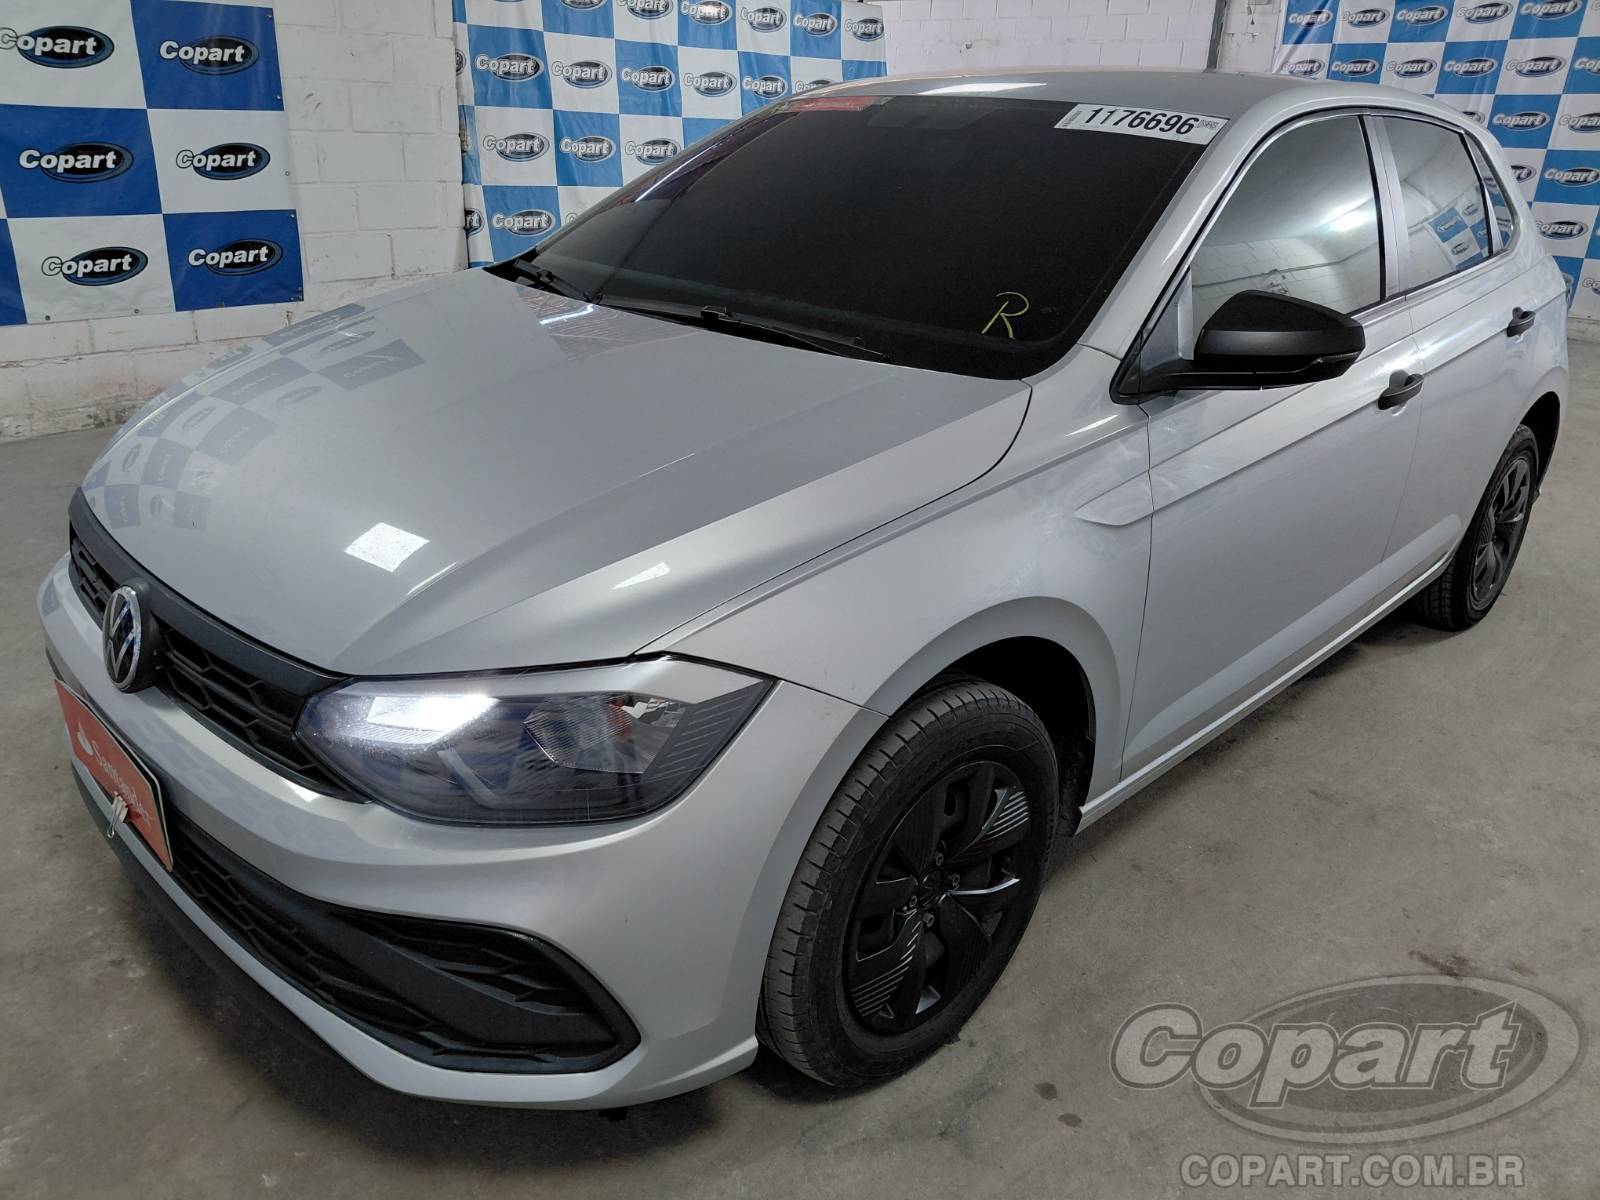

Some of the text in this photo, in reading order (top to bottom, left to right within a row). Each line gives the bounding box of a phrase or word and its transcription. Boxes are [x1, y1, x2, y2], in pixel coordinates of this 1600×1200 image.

[680, 1, 727, 19] Copart
[741, 7, 782, 25] Copart
[1341, 10, 1385, 23] Copart
[1396, 7, 1445, 23] Copart
[1456, 3, 1509, 19] Copart
[1520, 0, 1578, 16] Copart
[793, 14, 833, 31] Copart
[844, 19, 883, 34] Copart
[1289, 13, 1328, 24] Copart
[0, 27, 97, 56] Copart
[160, 40, 245, 64] Copart
[476, 54, 536, 75] Copart
[552, 61, 605, 80] Copart
[1331, 60, 1374, 74] Copart
[1386, 60, 1433, 74] Copart
[1443, 59, 1493, 75] Copart
[1506, 58, 1562, 73] Copart
[621, 68, 672, 86] Copart
[684, 72, 731, 91] Copart
[742, 76, 784, 94] Copart
[1085, 107, 1200, 135] 1176696
[1492, 112, 1546, 128] Copart
[1558, 113, 1600, 128] Copa
[483, 135, 542, 153] Copart
[560, 138, 610, 156] Copart
[625, 142, 674, 158] Copart
[19, 149, 117, 173] Copart
[176, 150, 256, 170] Copart
[1544, 168, 1597, 183] Copart
[492, 212, 549, 232] Copart
[42, 253, 133, 278] Copart
[188, 246, 270, 268] Copart
[981, 291, 1030, 340] R
